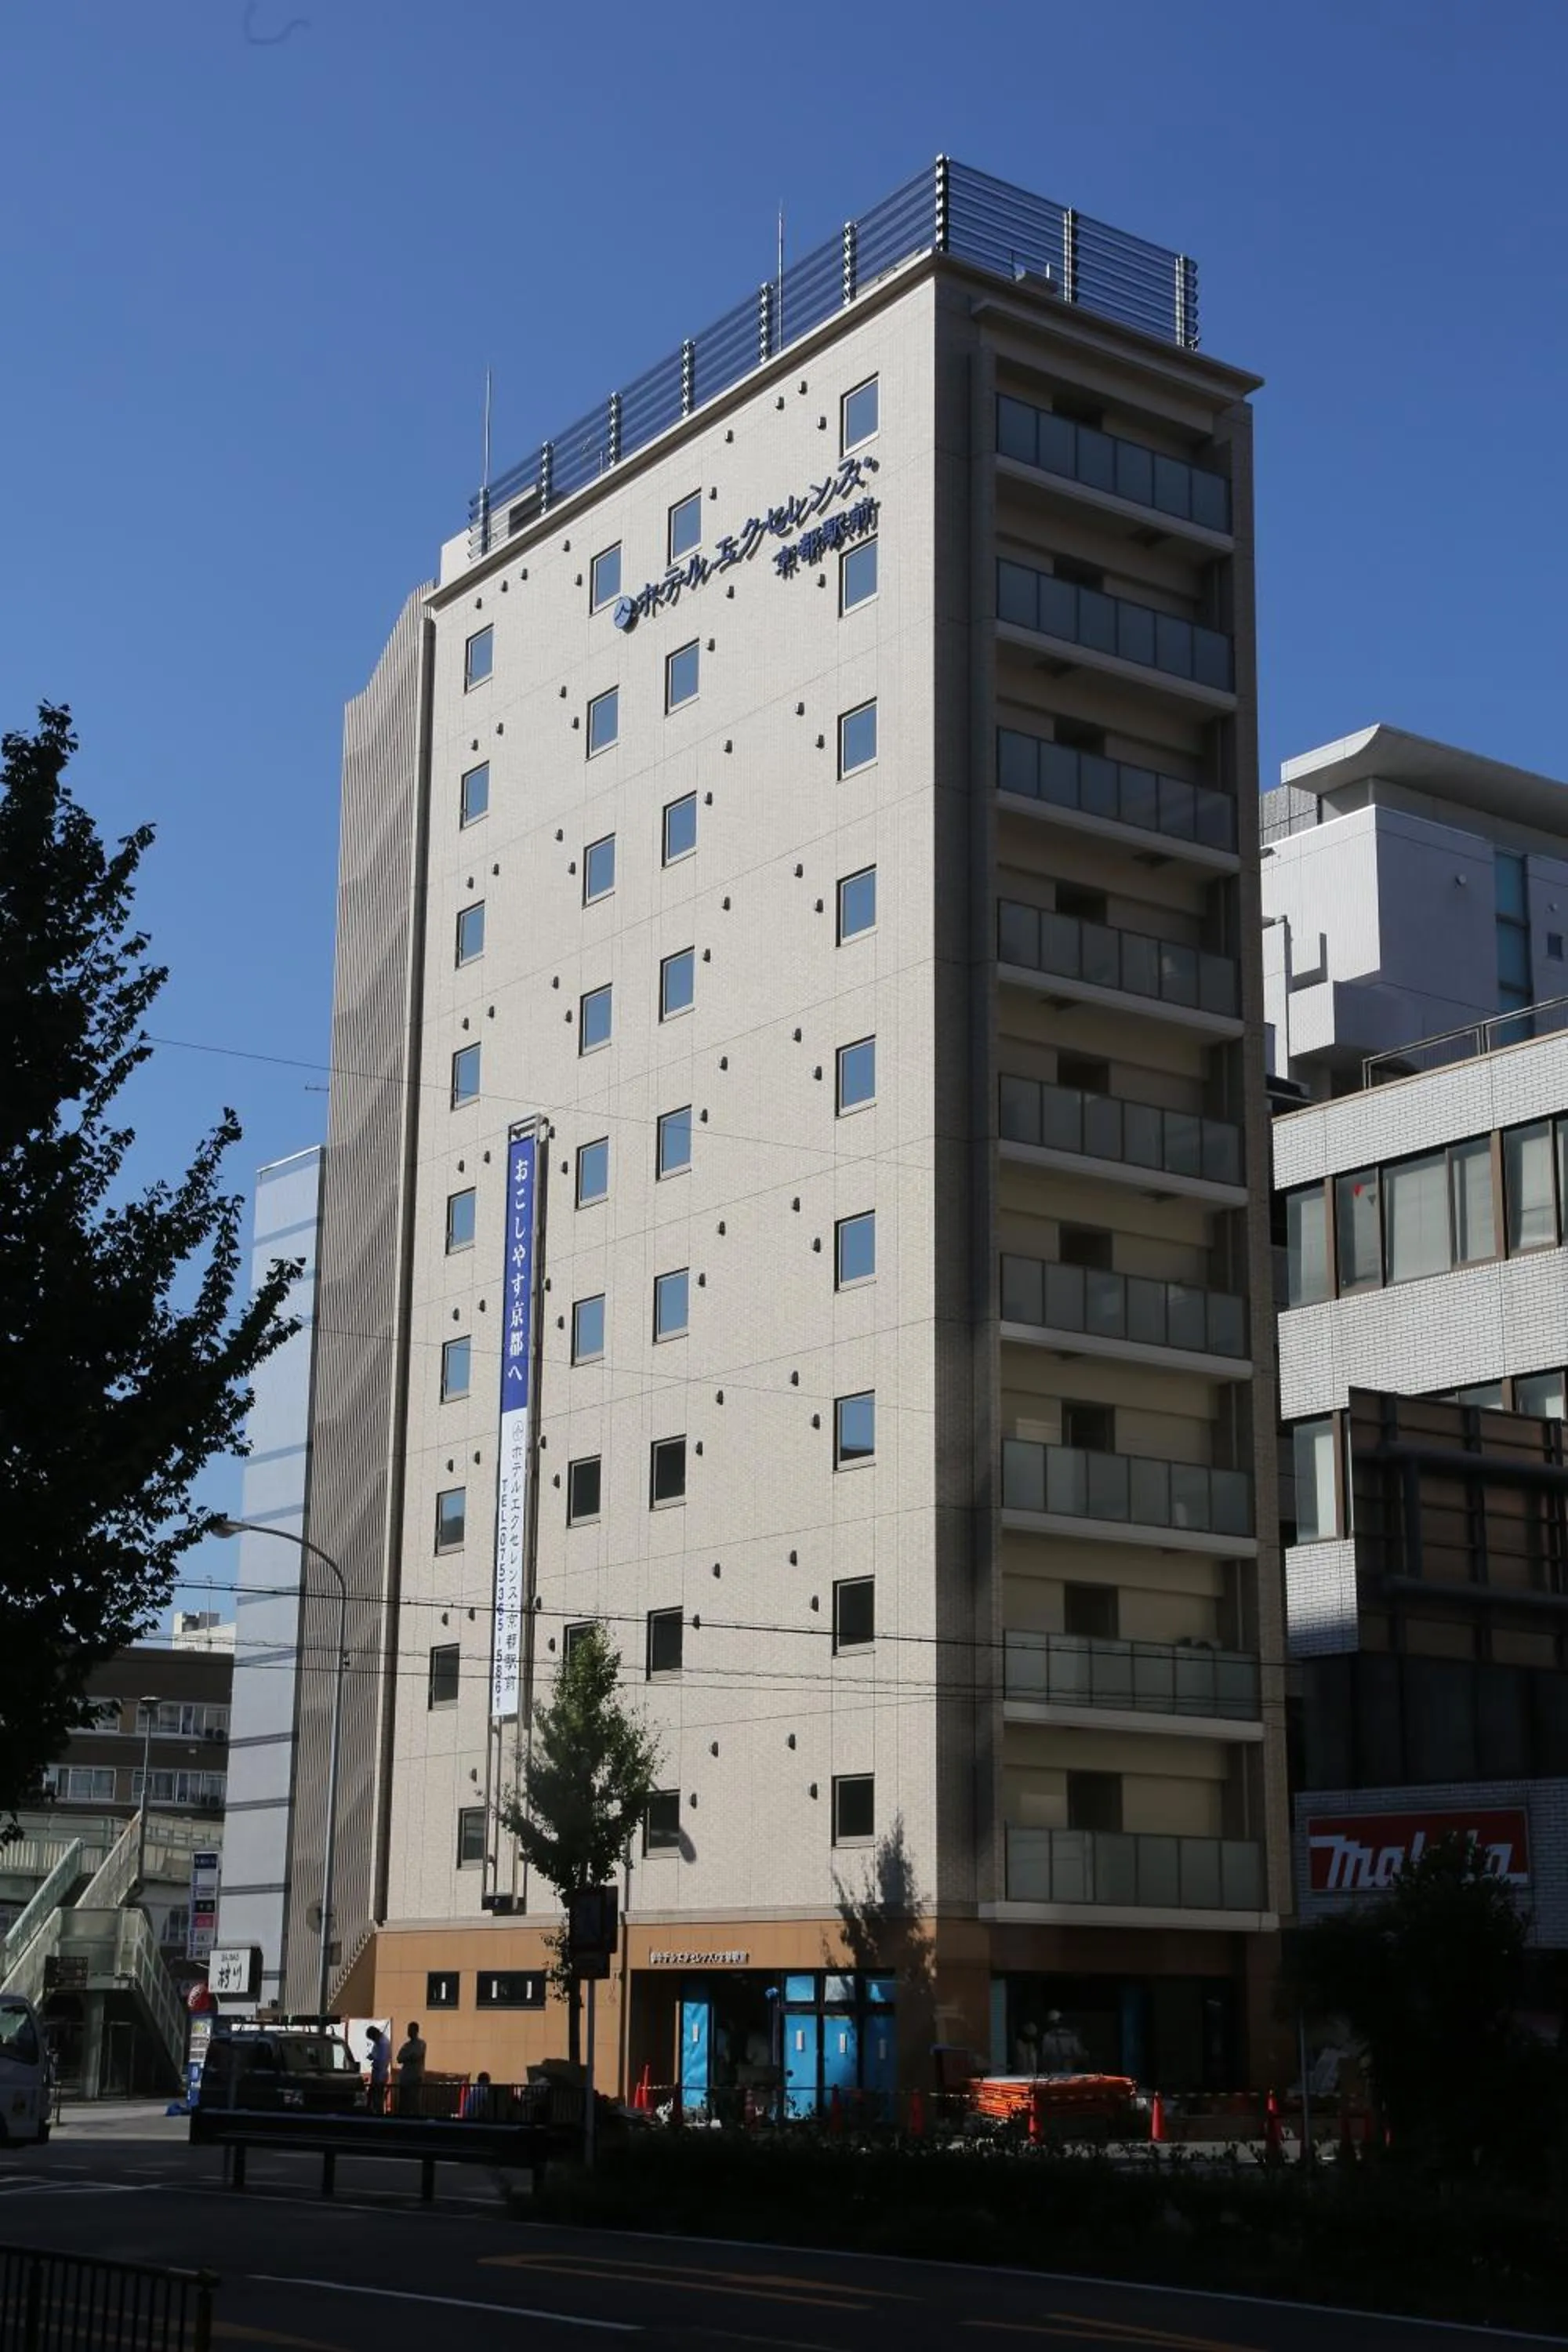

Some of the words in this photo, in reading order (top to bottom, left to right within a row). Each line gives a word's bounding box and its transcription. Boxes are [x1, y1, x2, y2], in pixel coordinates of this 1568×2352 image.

[772, 497, 876, 579] 京都駅前
[507, 1159, 529, 1381] おこしやす京都へ
